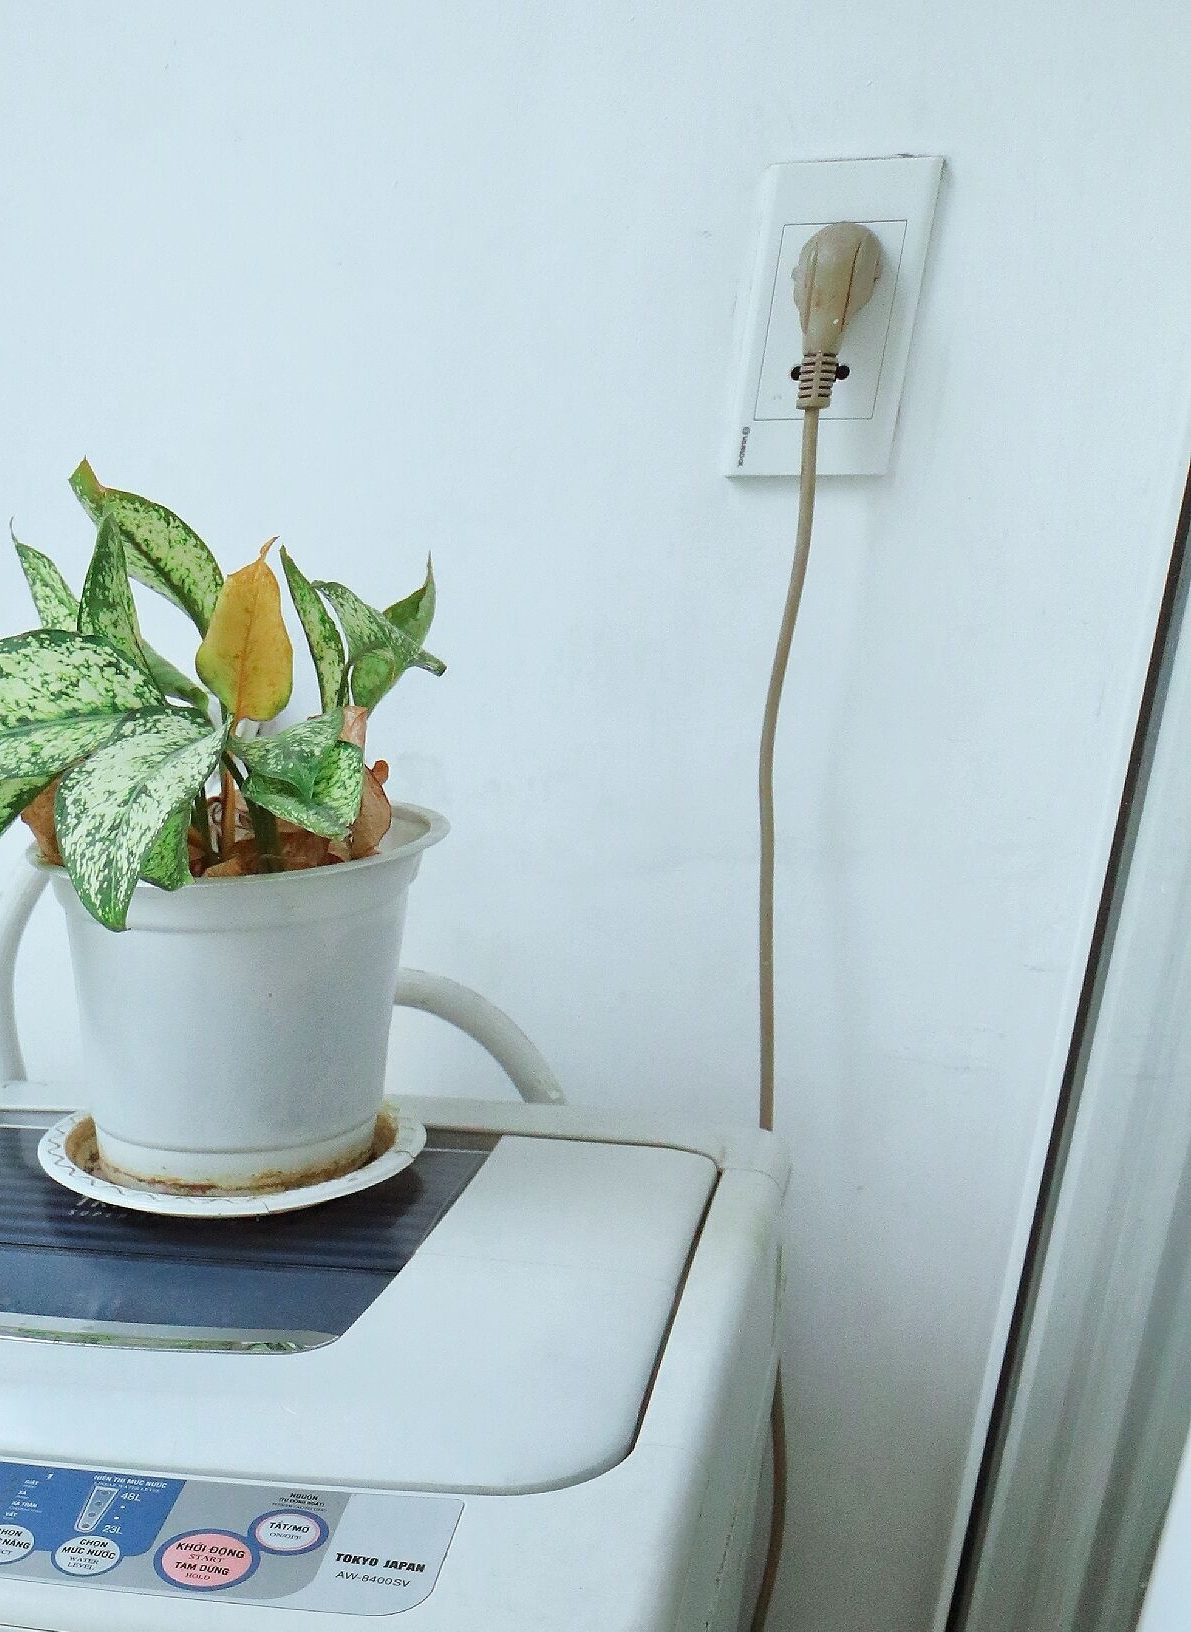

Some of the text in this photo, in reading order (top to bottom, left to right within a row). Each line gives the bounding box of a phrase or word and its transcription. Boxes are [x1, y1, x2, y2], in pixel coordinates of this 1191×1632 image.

[70, 1556, 100, 1564] WATER
[188, 1554, 224, 1564] START
[335, 1552, 426, 1572] TOKYO JAPAN
[67, 1562, 94, 1570] LEVEL
[184, 1572, 210, 1580] HOLD
